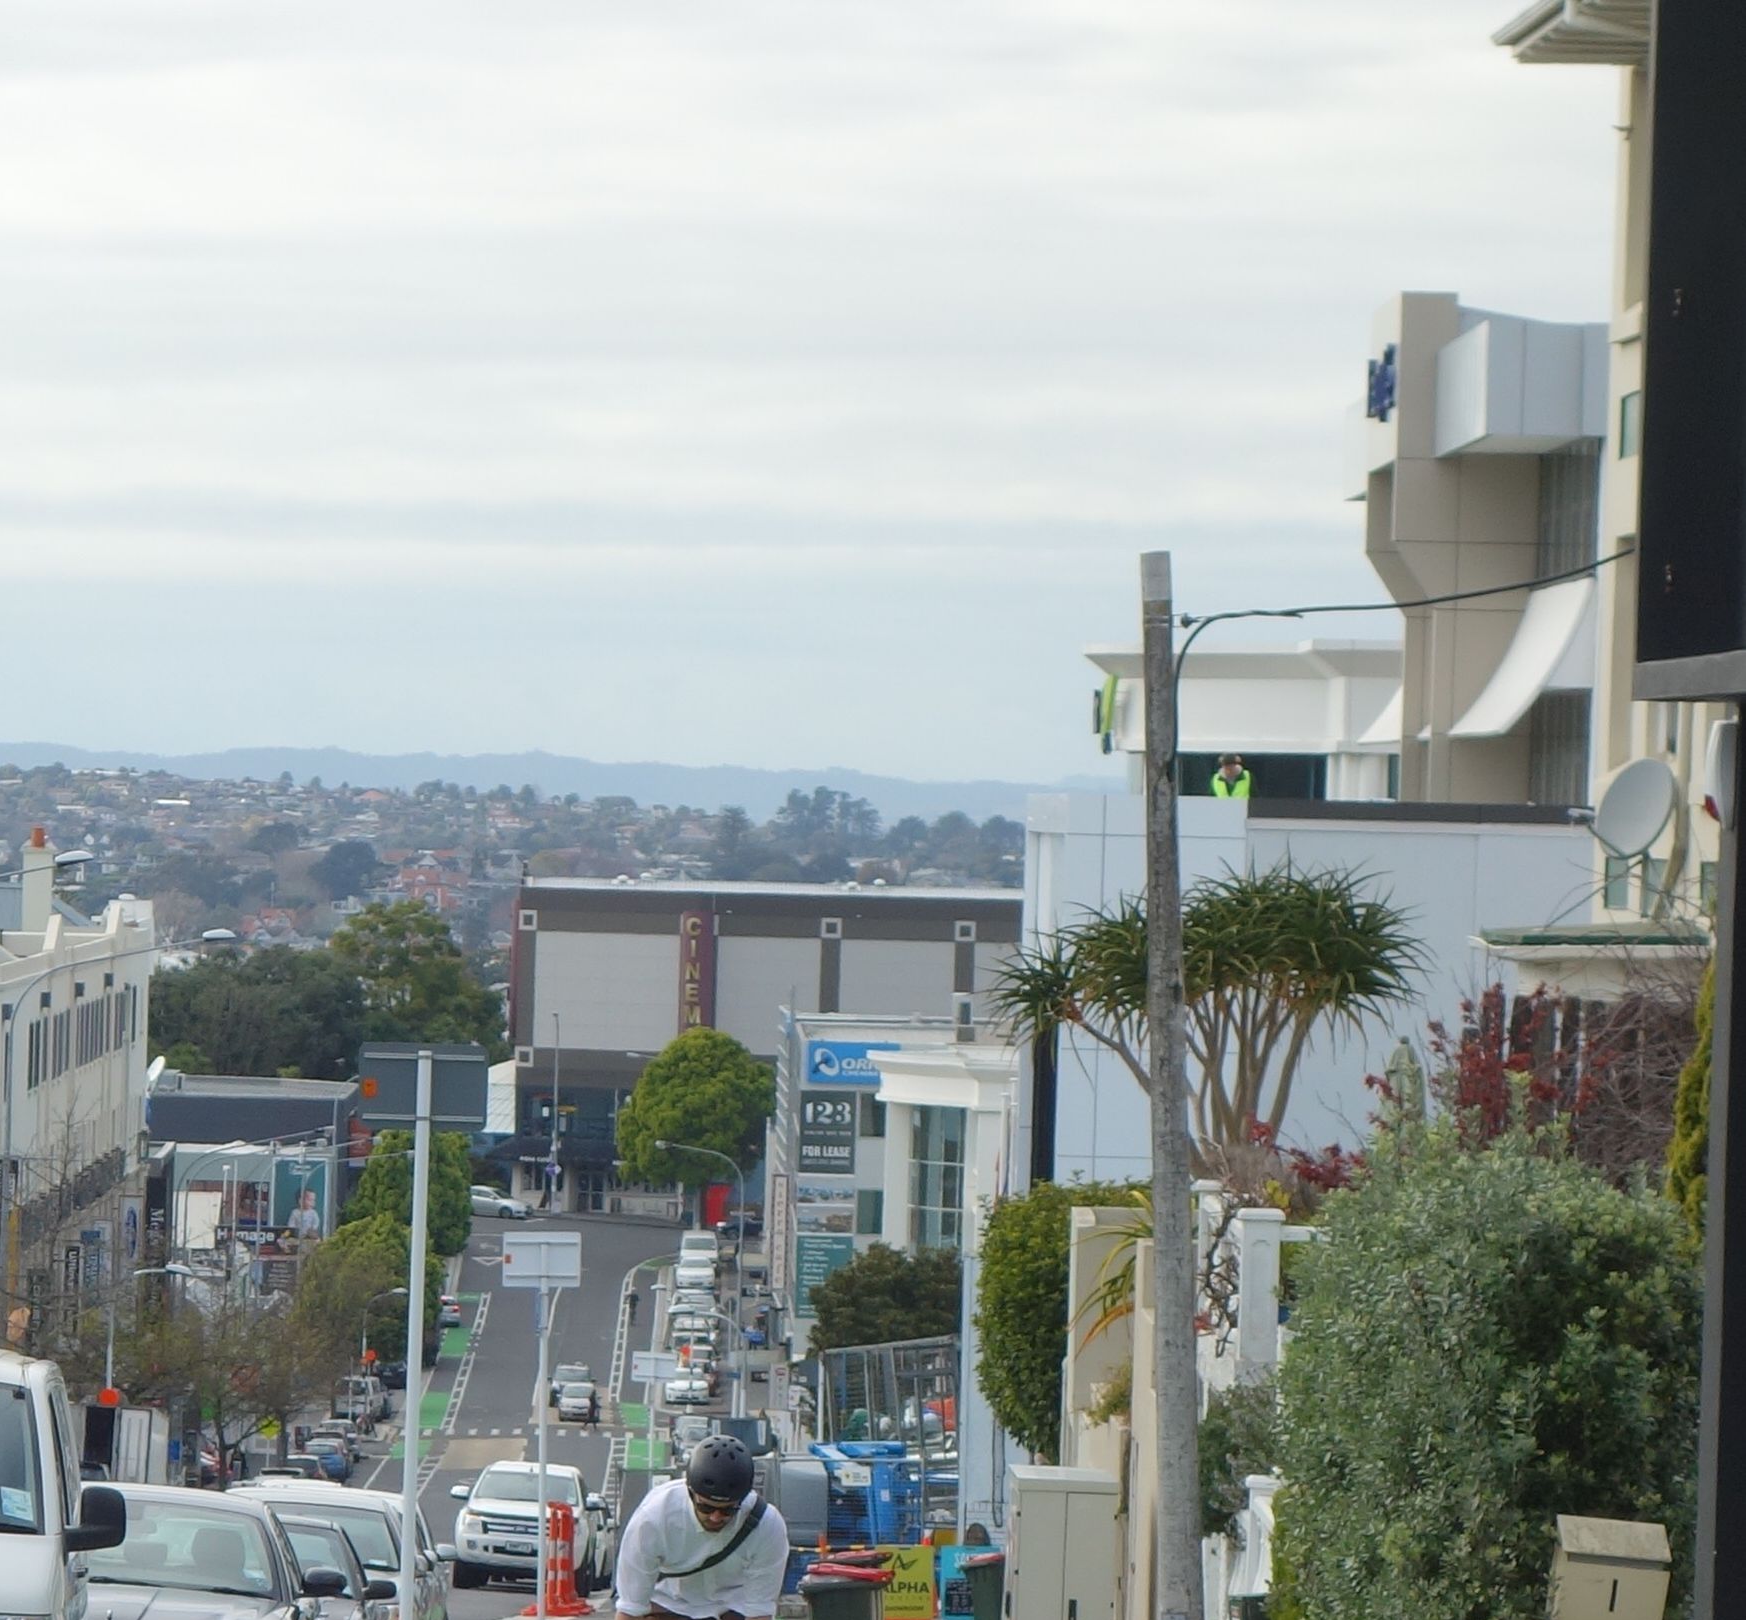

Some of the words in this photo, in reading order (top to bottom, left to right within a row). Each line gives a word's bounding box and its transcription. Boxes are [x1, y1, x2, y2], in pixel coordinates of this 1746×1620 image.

[684, 917, 703, 1025] CINEM
[805, 1101, 852, 1125] 123
[802, 1145, 821, 1157] FOR
[822, 1145, 851, 1158] LEASE
